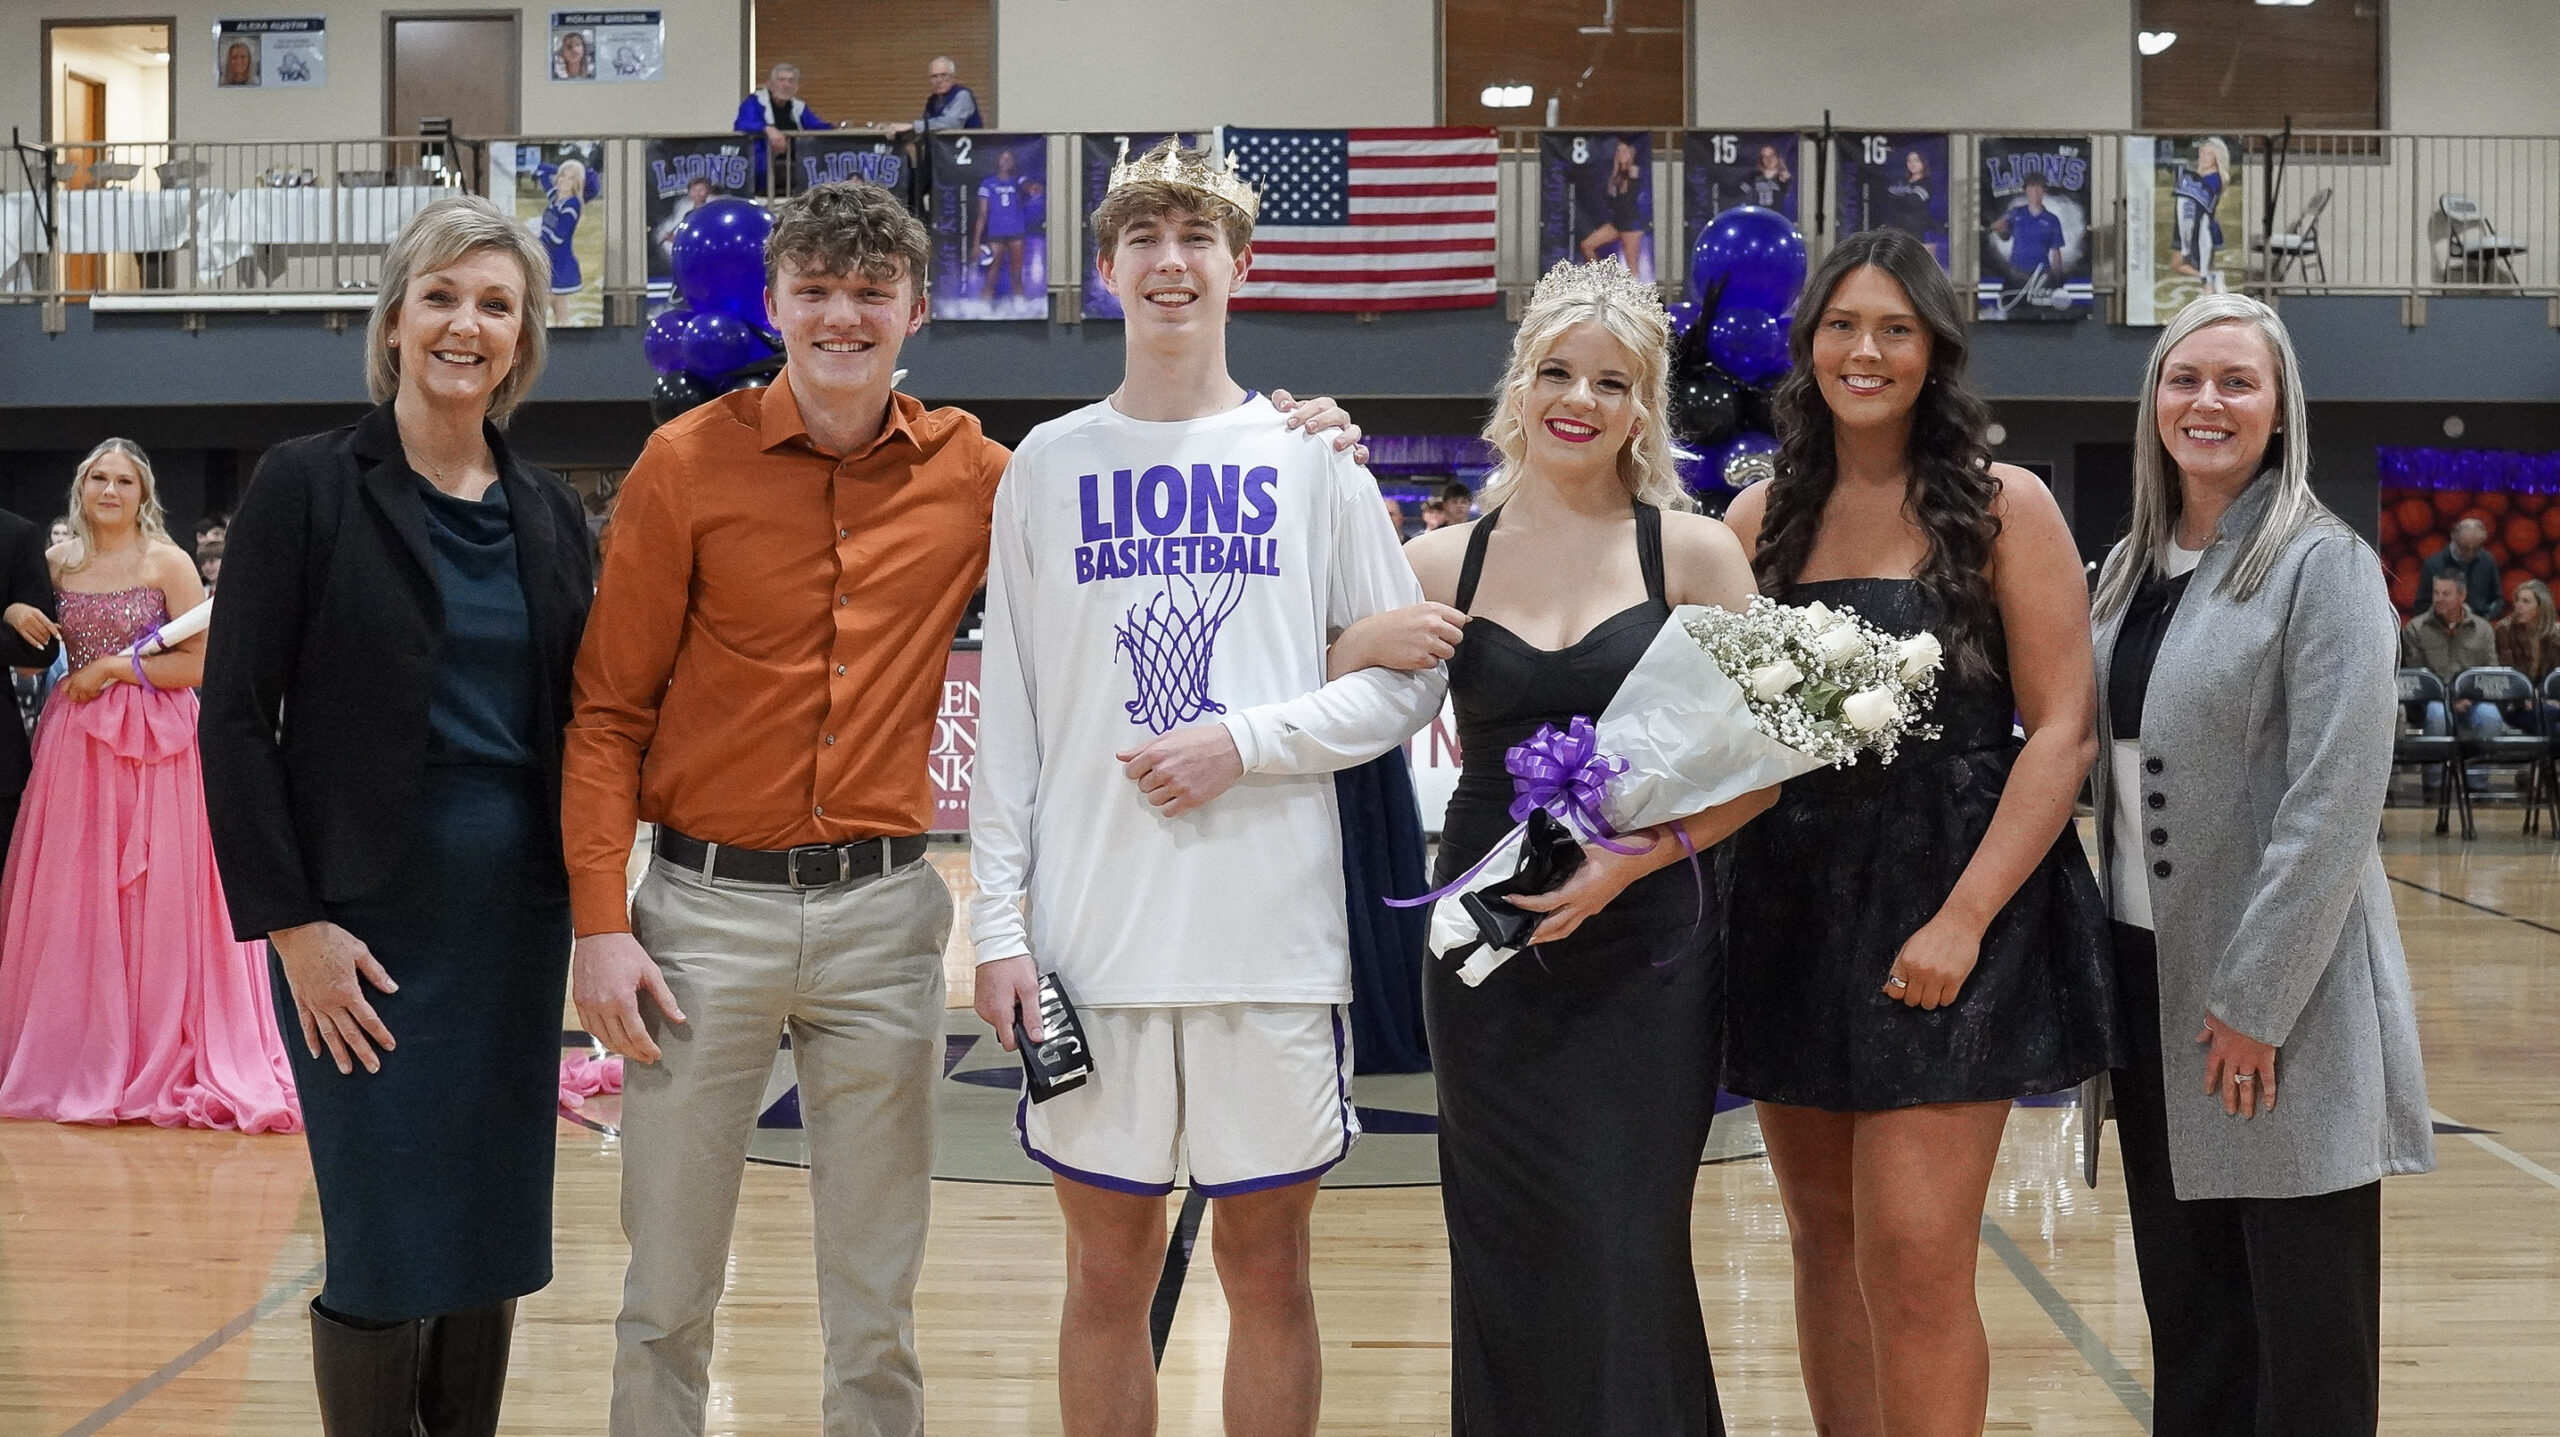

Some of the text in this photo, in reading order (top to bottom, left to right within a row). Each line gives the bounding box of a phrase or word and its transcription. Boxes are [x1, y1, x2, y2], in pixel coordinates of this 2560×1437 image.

[955, 136, 972, 165] 2
[1114, 136, 1129, 166] 7
[1572, 136, 1589, 164] 8
[1711, 135, 1738, 164] 15
[1861, 135, 1888, 165] 16
[652, 153, 748, 189] LIONS
[802, 151, 901, 190] LIONS
[1986, 152, 2086, 191] LIONS
[1079, 464, 1278, 544] LIONS
[1074, 536, 1280, 585] BASKETBALL
